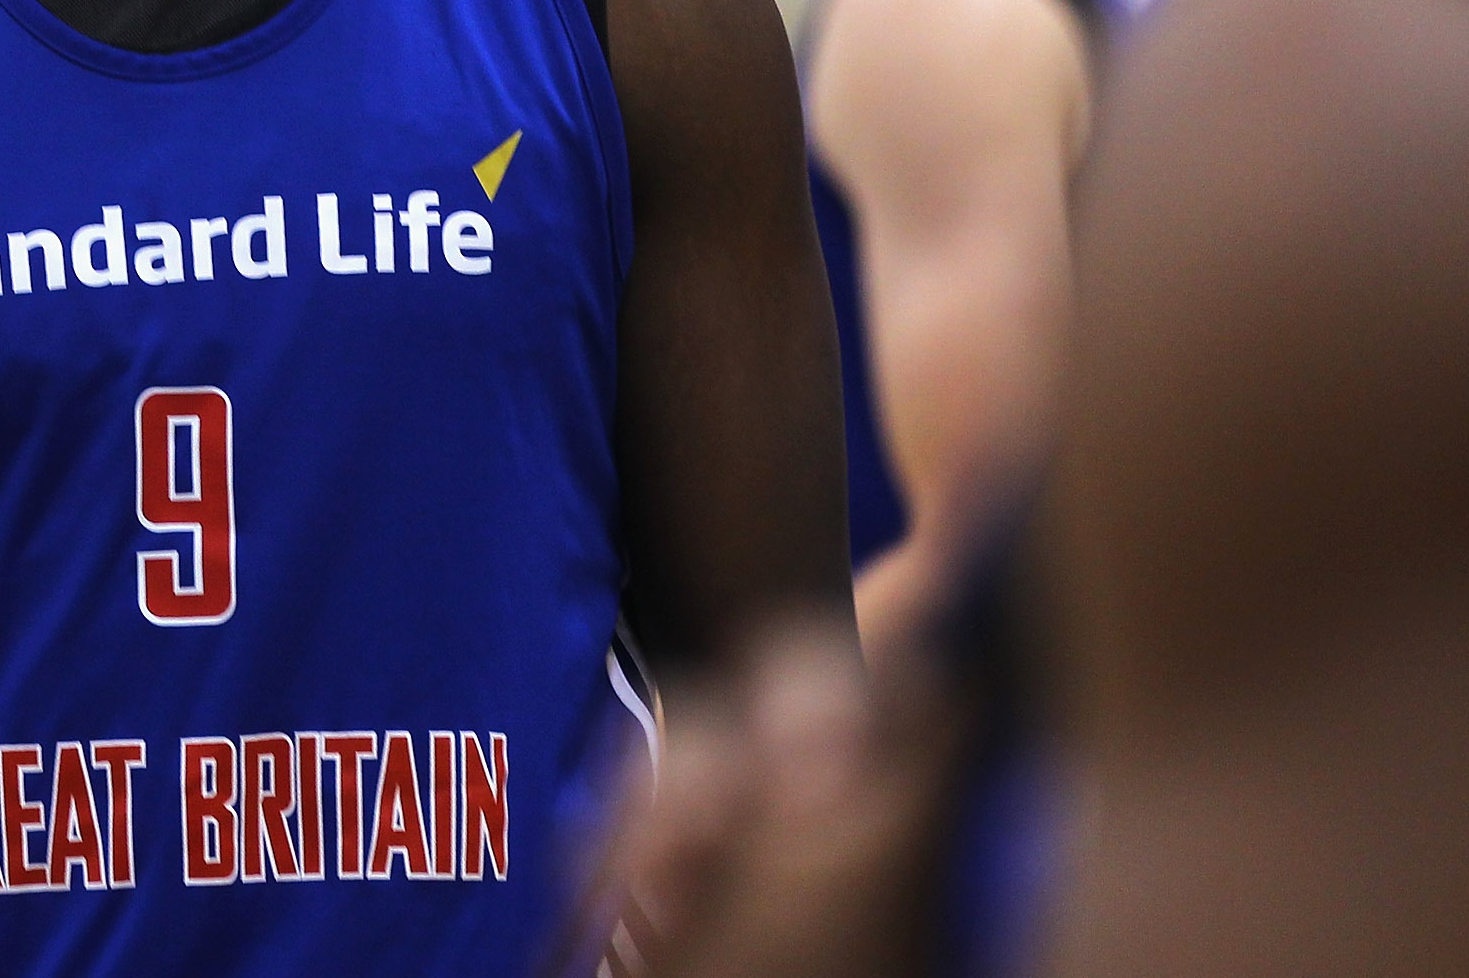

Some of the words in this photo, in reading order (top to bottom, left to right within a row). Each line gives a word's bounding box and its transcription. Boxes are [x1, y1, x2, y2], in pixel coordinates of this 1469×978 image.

[317, 190, 494, 276] Life
[134, 385, 237, 626] 9
[180, 730, 508, 886] BRITAIN
